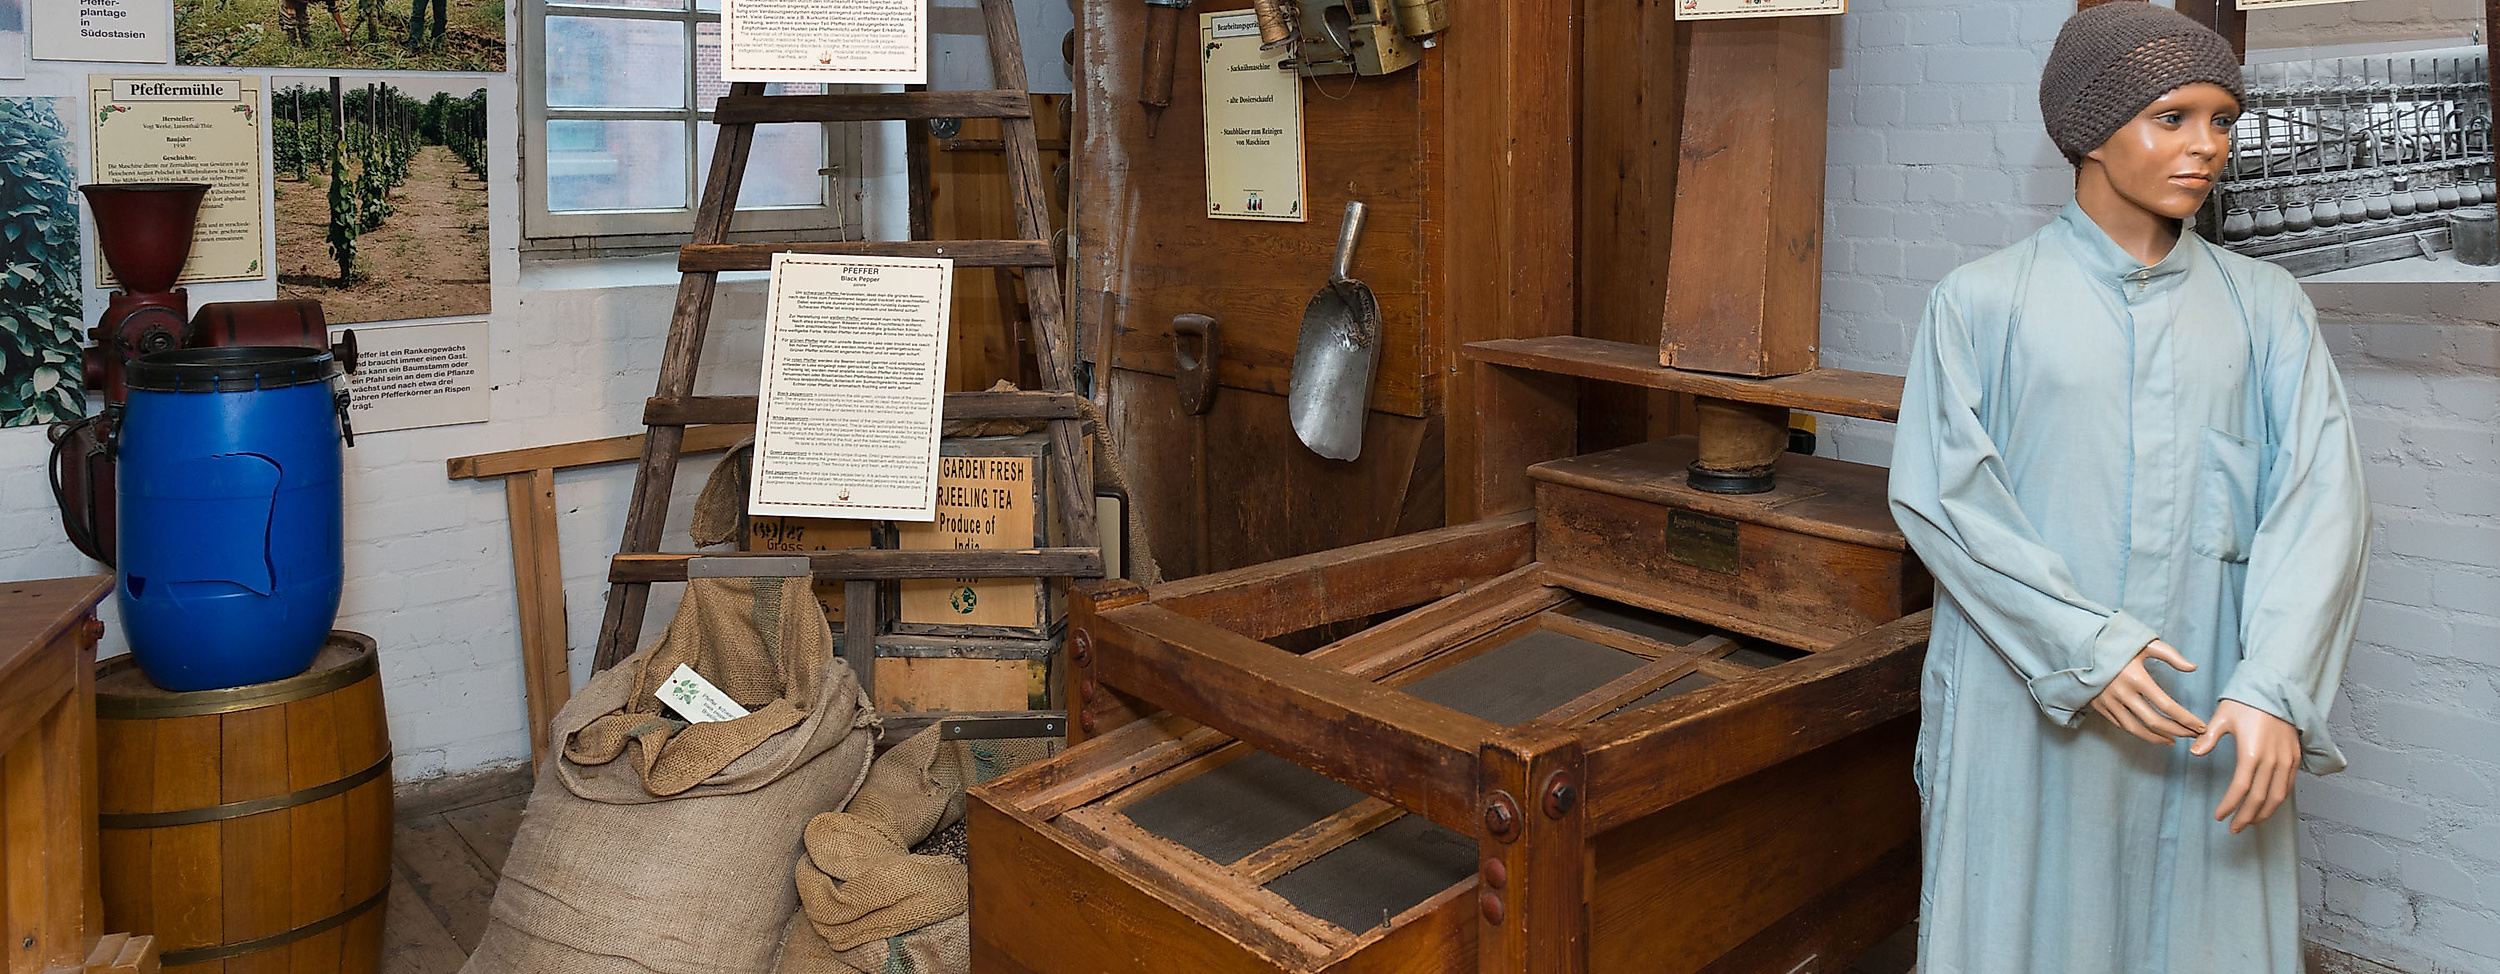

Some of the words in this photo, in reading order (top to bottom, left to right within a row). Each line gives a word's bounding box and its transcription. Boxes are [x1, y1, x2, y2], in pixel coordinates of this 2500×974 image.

[80, 8, 126, 18] plantage
[80, 28, 146, 38] Südostasien
[130, 83, 224, 96] Pfeffermühle
[1239, 95, 1274, 104] Dosierschaufel
[1262, 128, 1283, 136] Reinigen
[404, 345, 466, 355] Rankengewächs
[402, 363, 449, 372] Baumstamm
[381, 390, 432, 399] Pfefferkörner
[445, 386, 471, 394] Rispen
[943, 458, 985, 479] GARDEN
[990, 461, 1024, 482] FRESH
[938, 486, 988, 508] RJEELING
[992, 489, 1012, 509] TEA
[940, 512, 981, 534] Produce
[985, 515, 996, 535] of
[767, 538, 804, 551] Gross
[955, 538, 980, 550] India
